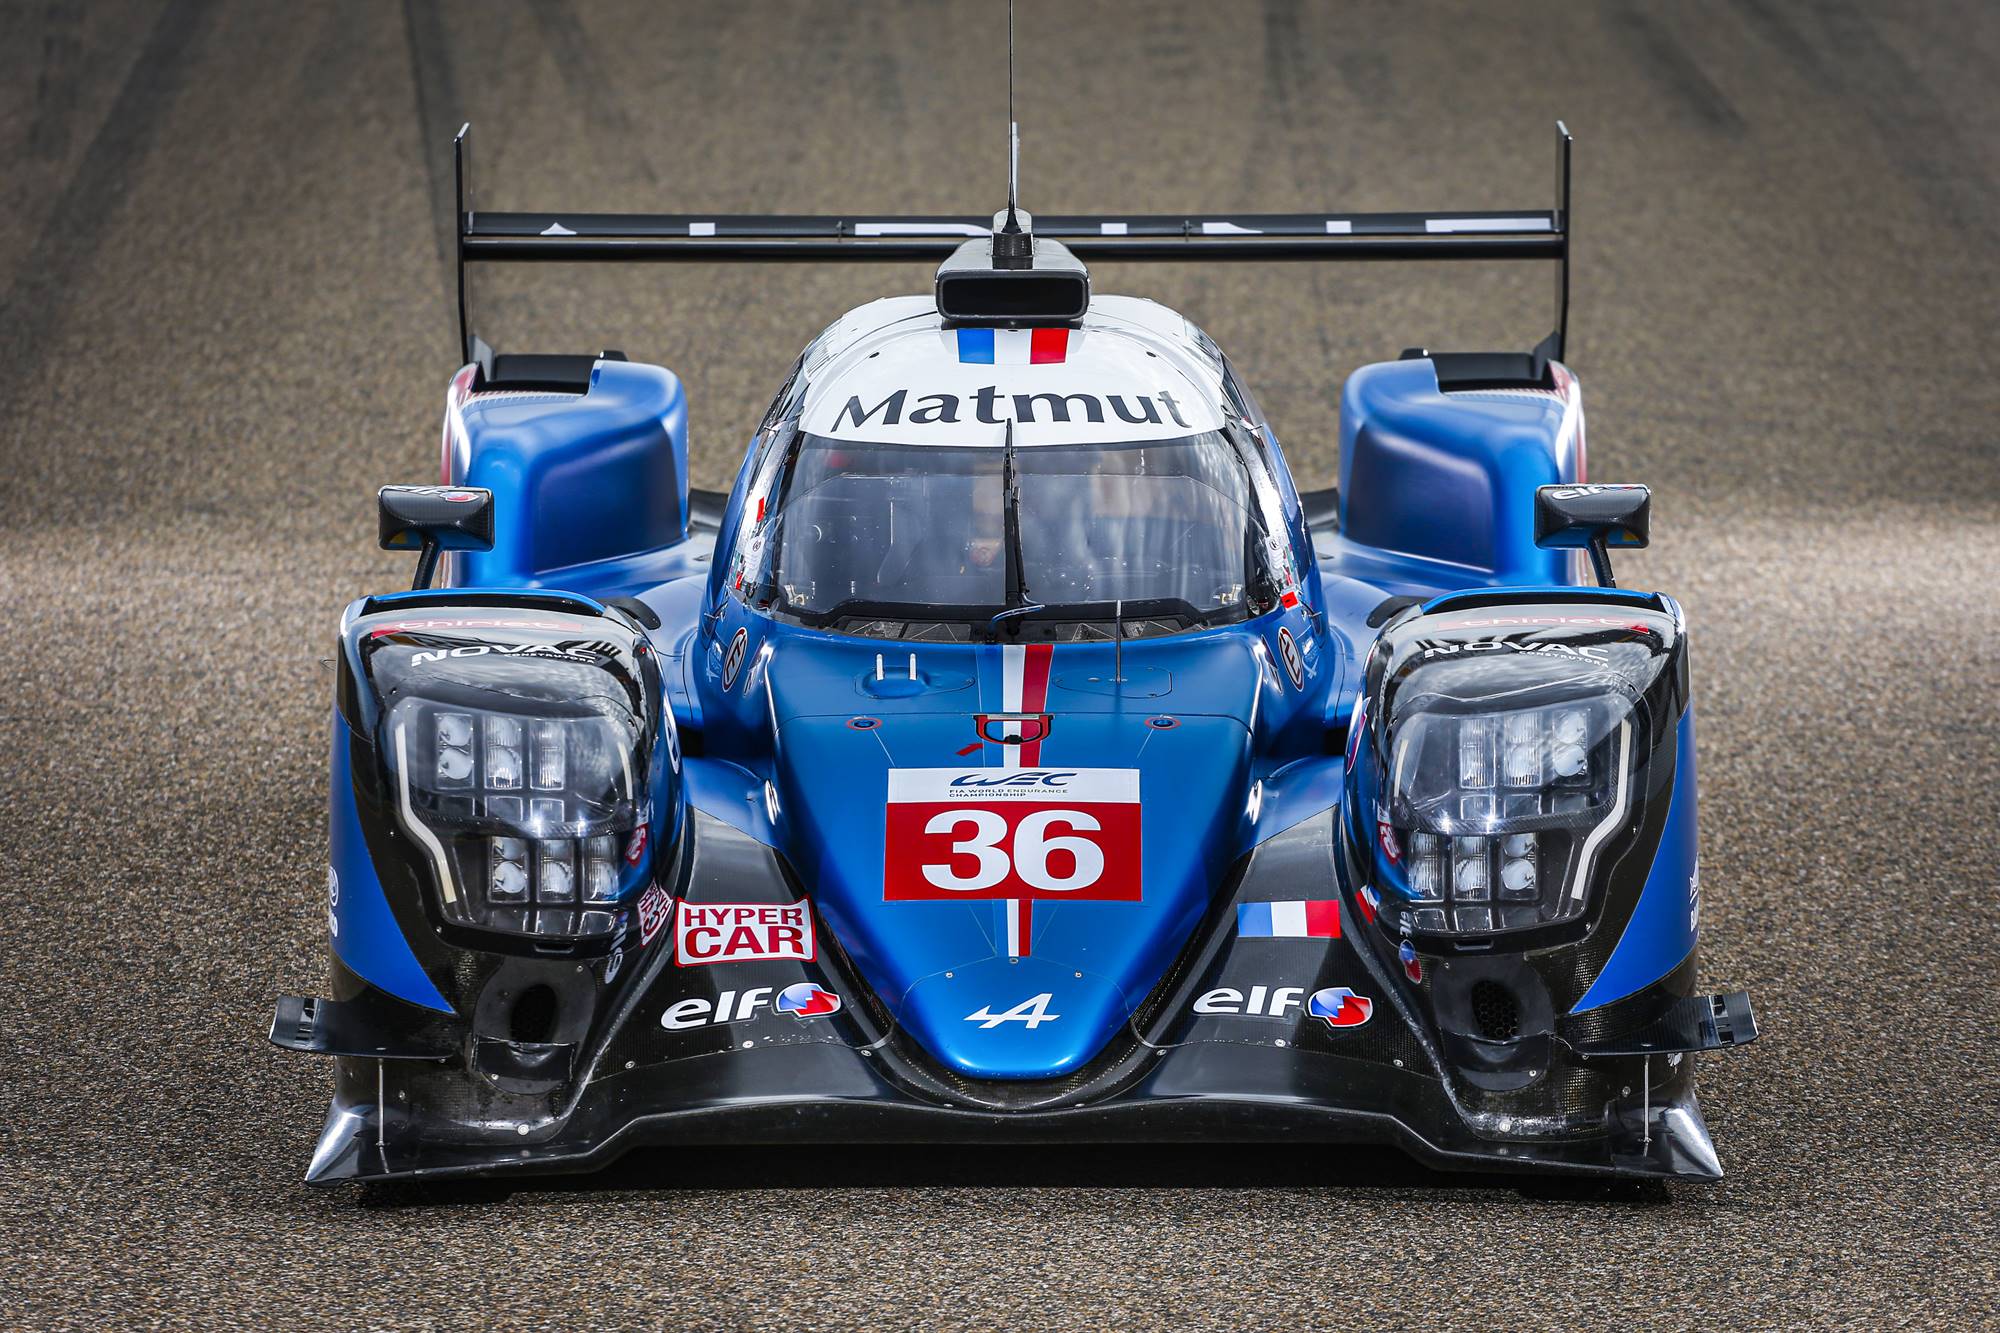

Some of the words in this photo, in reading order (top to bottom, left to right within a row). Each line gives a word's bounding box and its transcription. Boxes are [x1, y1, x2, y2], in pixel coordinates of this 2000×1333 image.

[831, 385, 1192, 432] Matmut
[411, 644, 597, 666] NOVAC
[504, 652, 595, 664] CONSTRUTORA
[1424, 641, 1609, 661] NOVAC
[1518, 650, 1609, 668] CONSTRUTORA
[949, 771, 1078, 787] WEC
[921, 809, 1105, 891] 36
[684, 908, 803, 927] HYPER
[685, 925, 805, 959] CAR
[660, 987, 773, 1030] elf
[1192, 985, 1305, 1017] elf
